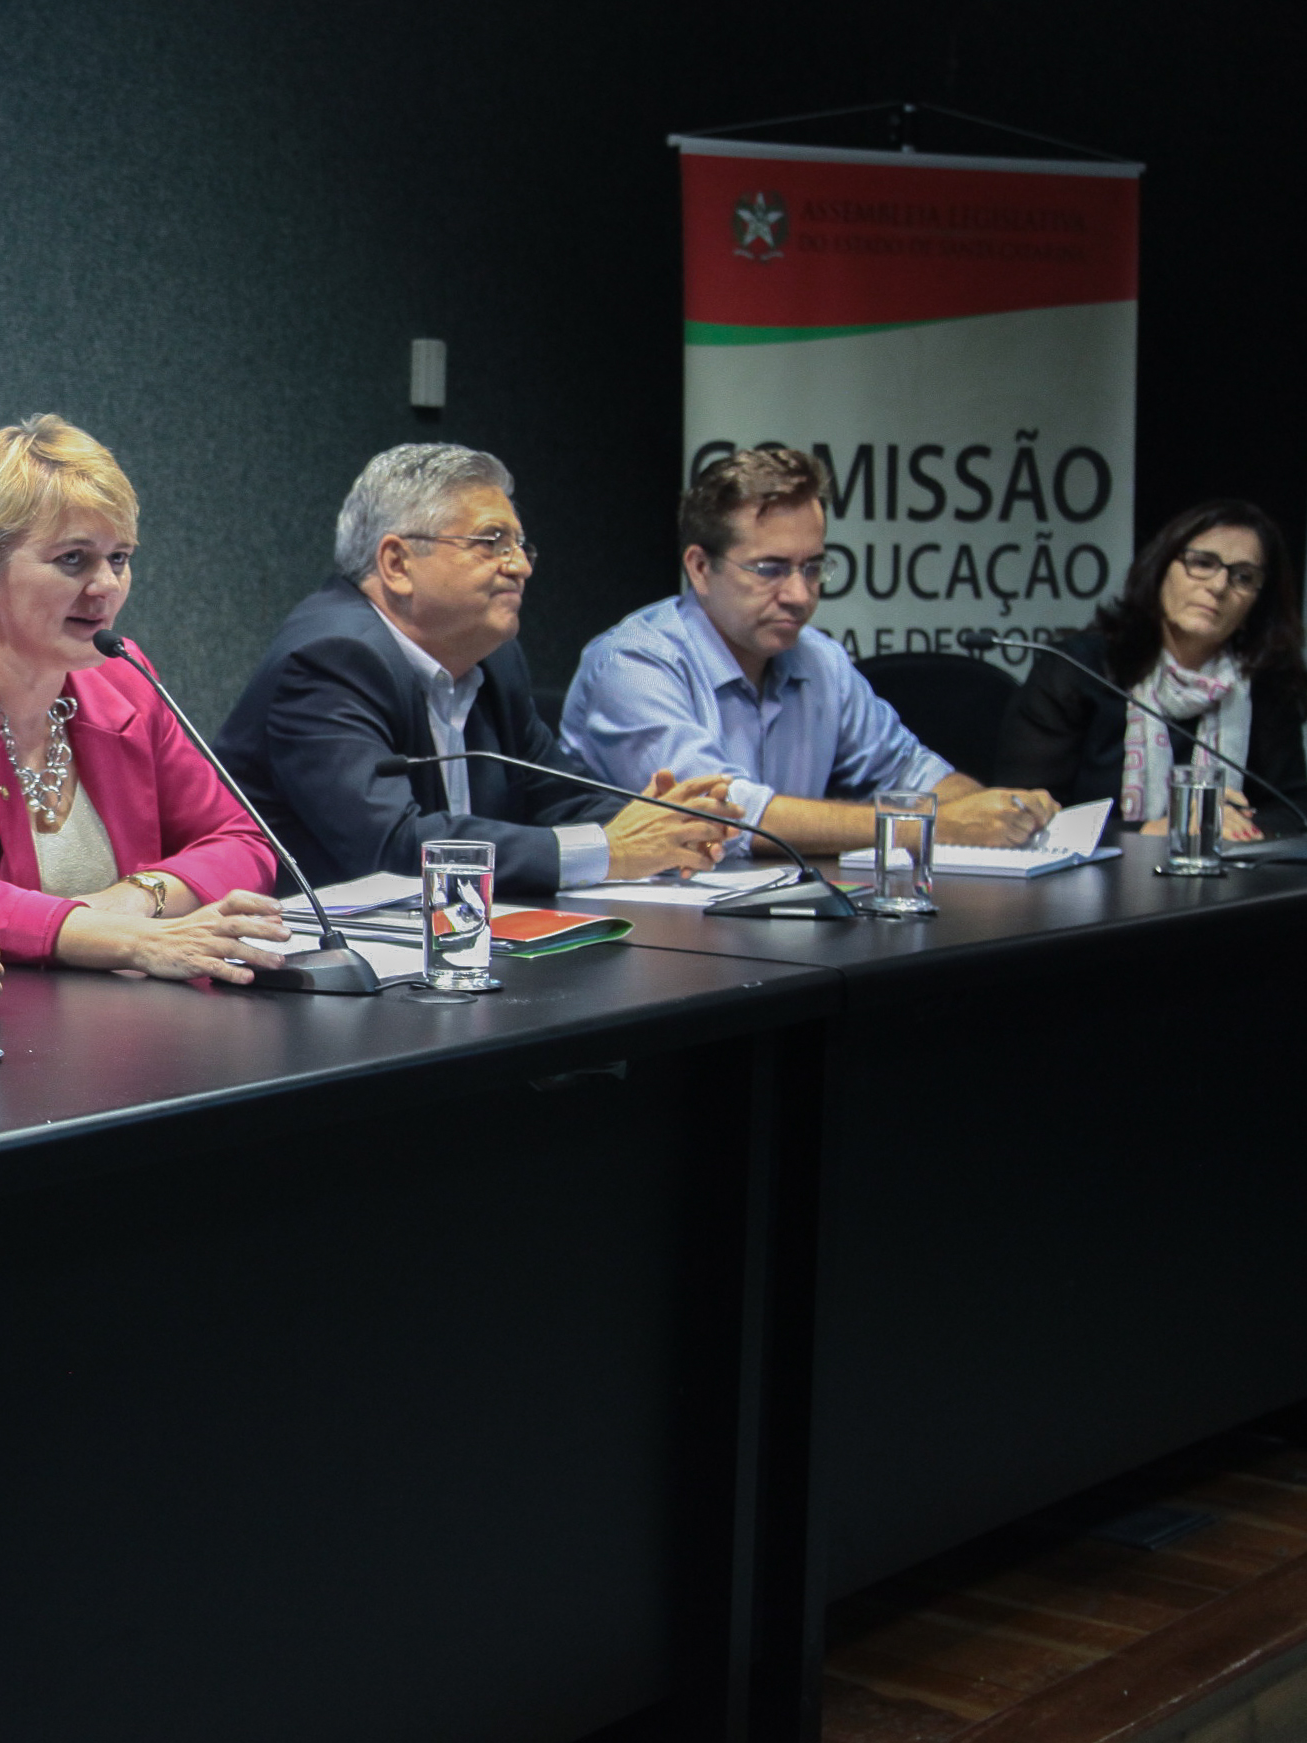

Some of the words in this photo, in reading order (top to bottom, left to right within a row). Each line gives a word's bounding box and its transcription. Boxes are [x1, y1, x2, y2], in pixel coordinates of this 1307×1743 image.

[943, 204, 1087, 234] LEGISLATIVA
[691, 429, 1113, 524] MISSÃO
[820, 531, 1110, 616] DUCAÇÃO
